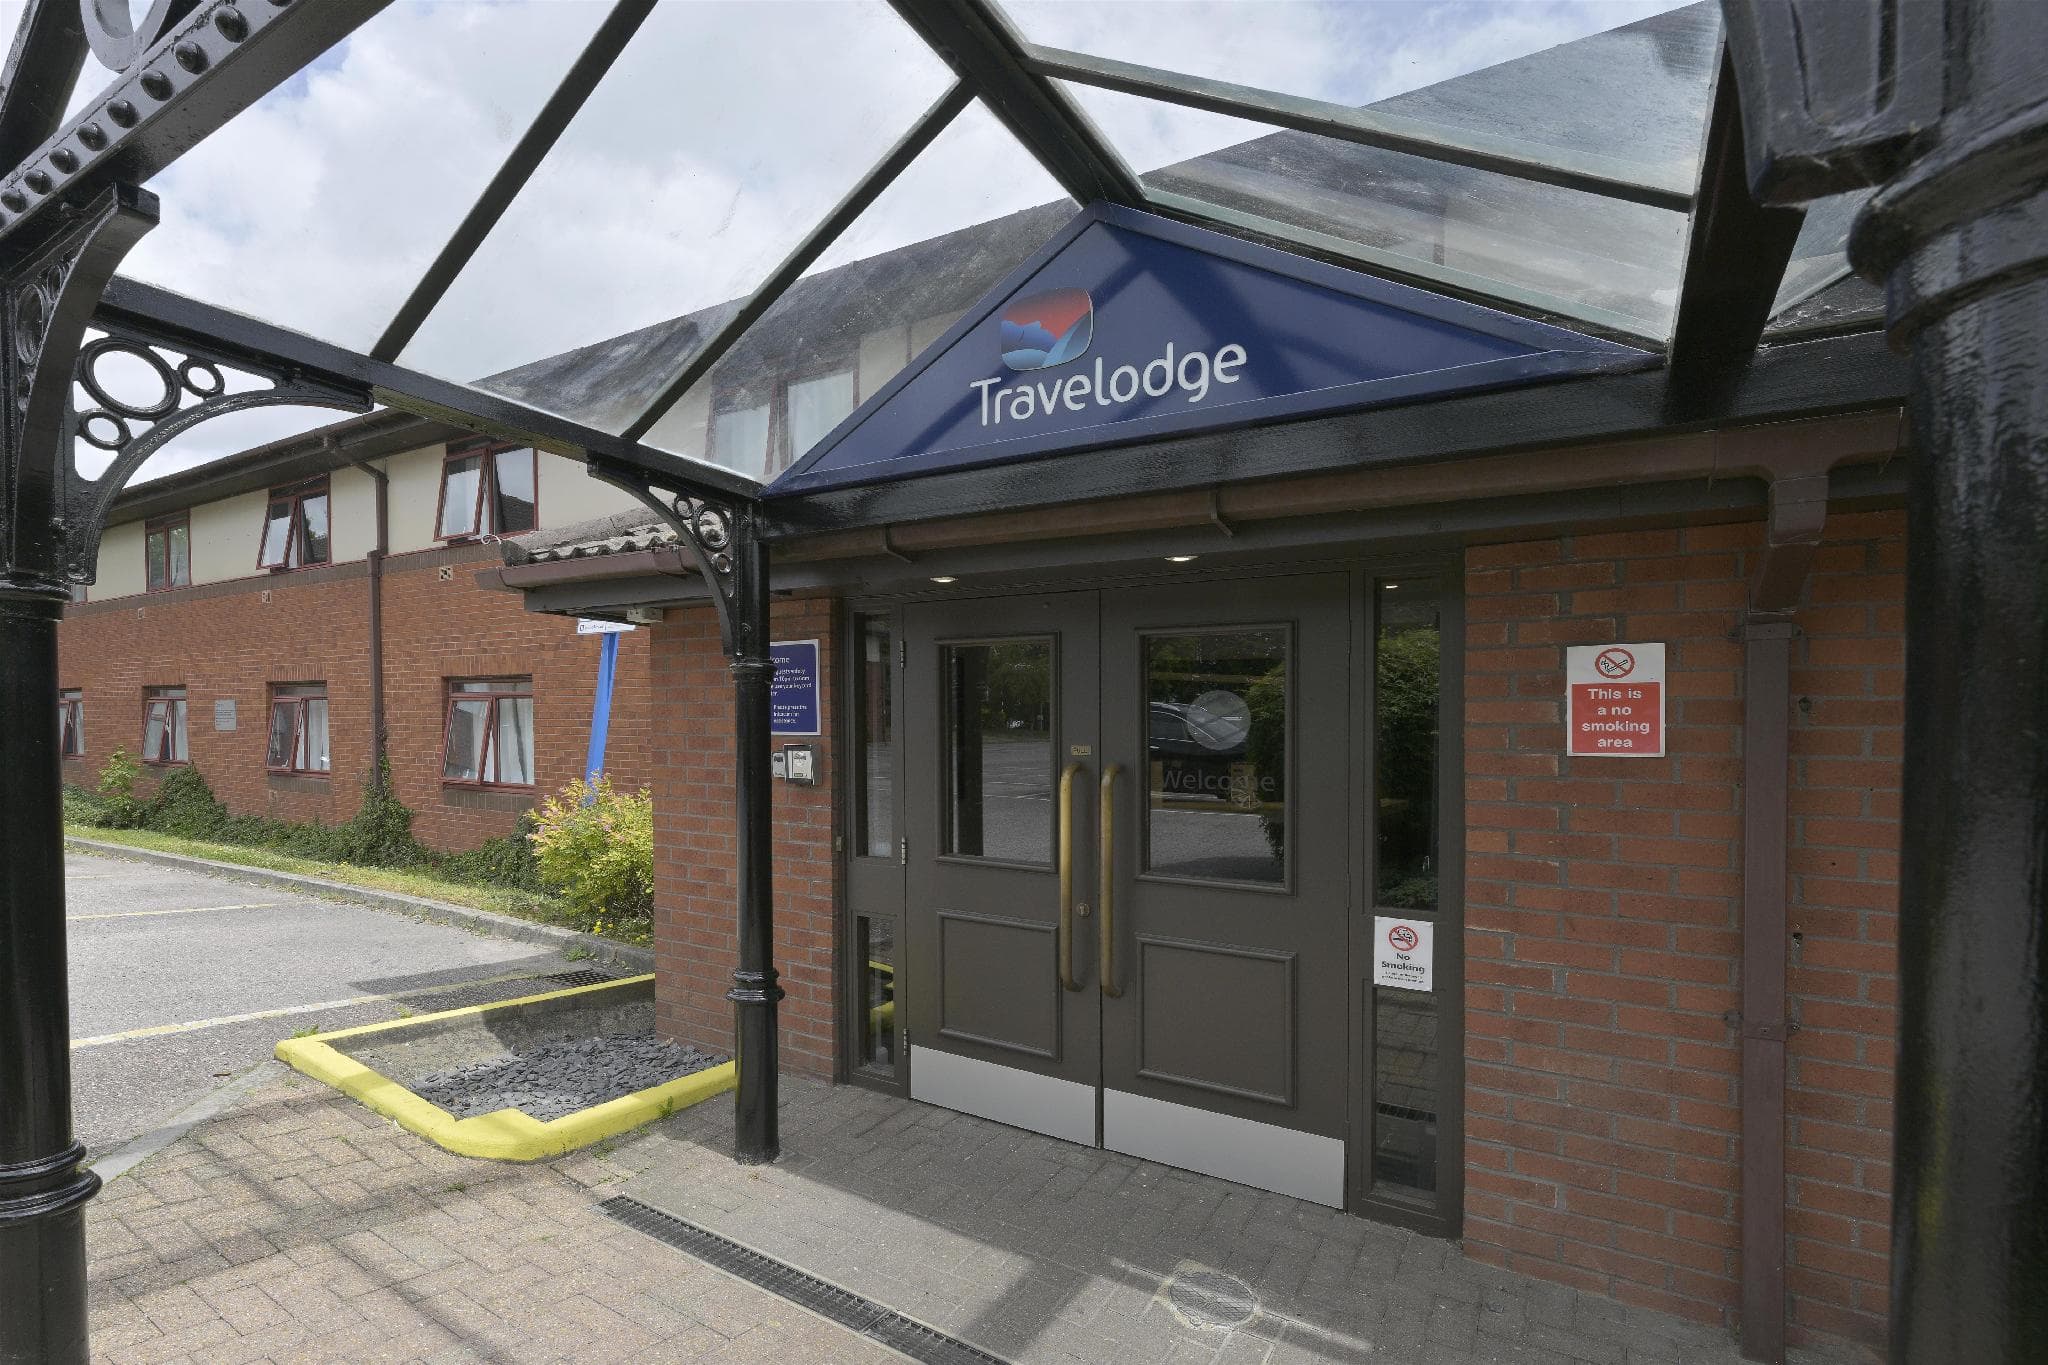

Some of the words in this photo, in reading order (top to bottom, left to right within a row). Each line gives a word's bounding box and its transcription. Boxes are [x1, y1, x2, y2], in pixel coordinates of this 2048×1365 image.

[969, 341, 1247, 427] Travelodge
[1587, 688, 1622, 700] This
[1628, 688, 1642, 699] is
[1597, 706, 1607, 715] a
[1611, 706, 1632, 715] no
[1582, 720, 1650, 734] smoking
[1597, 738, 1633, 748] area
[1396, 953, 1411, 961] No
[1381, 961, 1425, 975] Smoking
